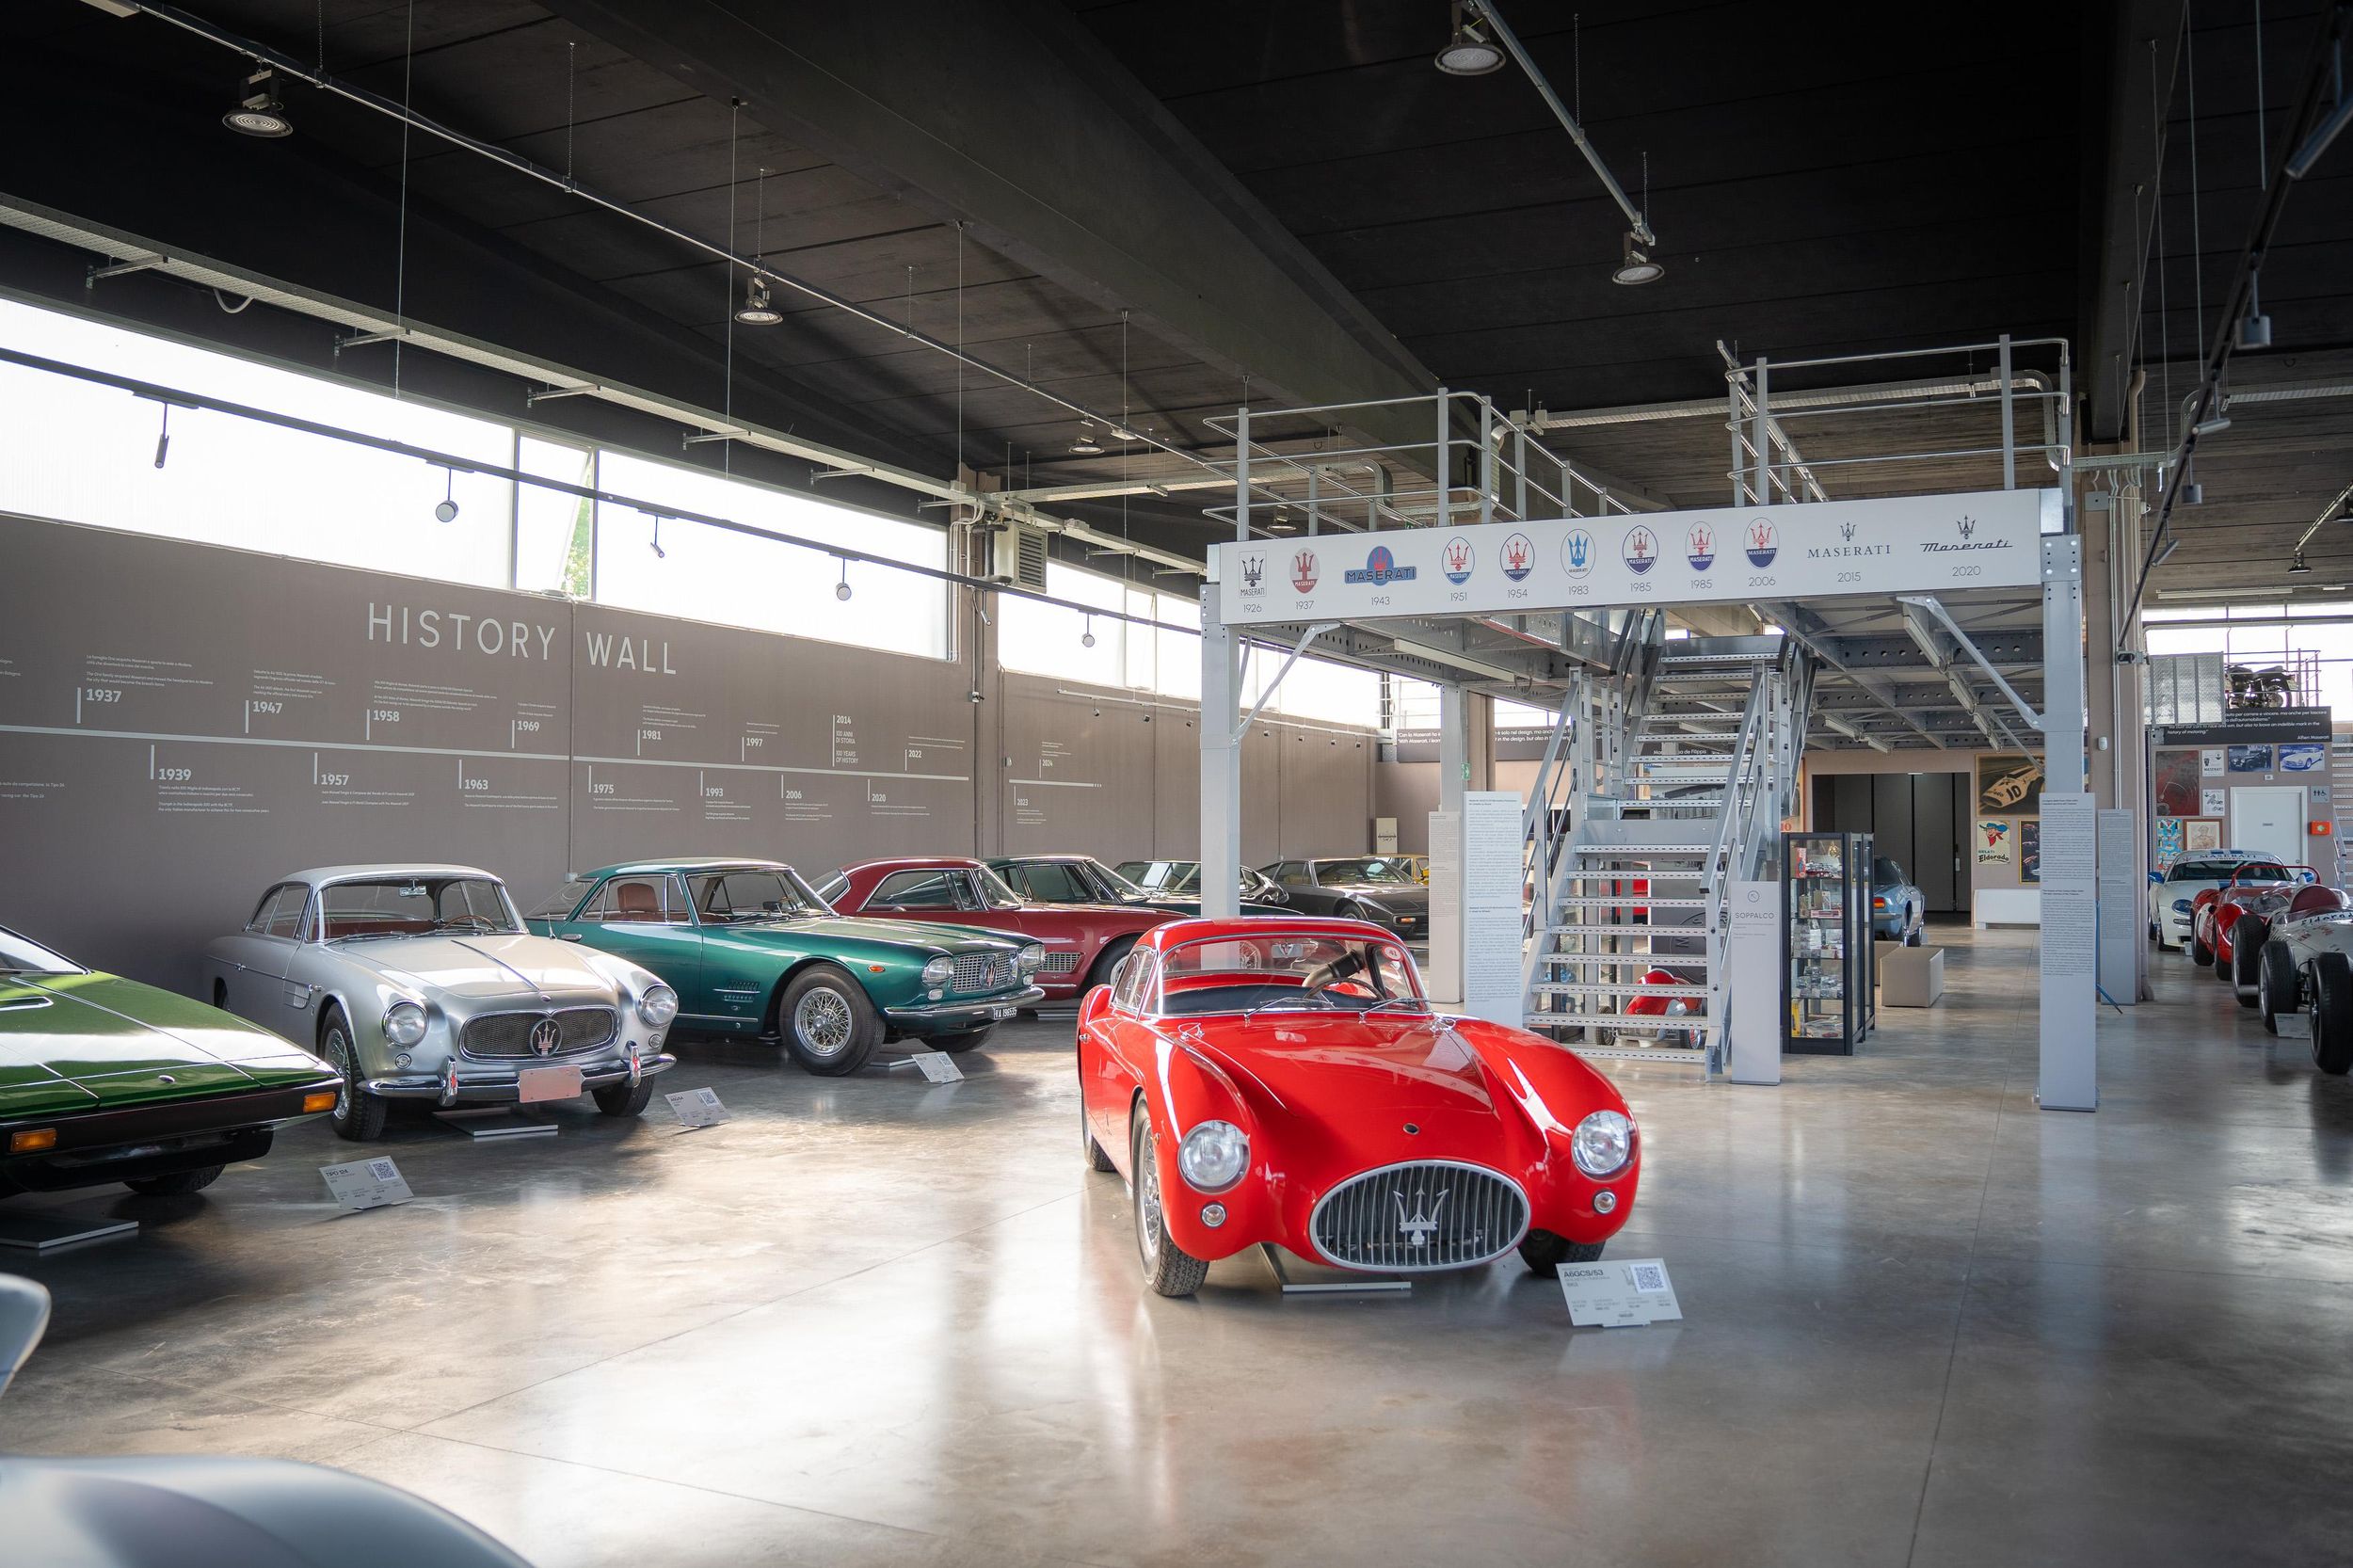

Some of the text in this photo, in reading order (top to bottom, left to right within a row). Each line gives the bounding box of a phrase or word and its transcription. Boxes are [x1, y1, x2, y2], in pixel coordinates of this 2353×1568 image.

[1920, 538, 2013, 552] Maserati
[1807, 544, 1891, 558] MASERATI
[1347, 568, 1416, 583] MASERATI
[1240, 587, 1265, 597] MASERATI
[1243, 566, 1981, 613] 1926 1937 1943 1951 1954 1983 1985 1985 2006 2015 2020
[367, 602, 677, 675] HISTORY WALL
[87, 688, 121, 702] 1937
[253, 701, 282, 714] 1947
[374, 710, 400, 722] 1958
[836, 715, 852, 724] 2014
[518, 721, 539, 731] 1969
[642, 730, 662, 740] 1981
[746, 737, 763, 747] 1997
[1042, 759, 1053, 767] 2024
[159, 768, 192, 781] 1939
[321, 775, 349, 785] 1957
[464, 779, 488, 790] 1963
[593, 784, 615, 793] 1975
[706, 788, 724, 797] 1993
[786, 791, 802, 799] 2006
[872, 793, 886, 802] 2020
[1978, 854, 2009, 863] Eldorado
[1563, 1269, 1604, 1278] A6GCS/53
